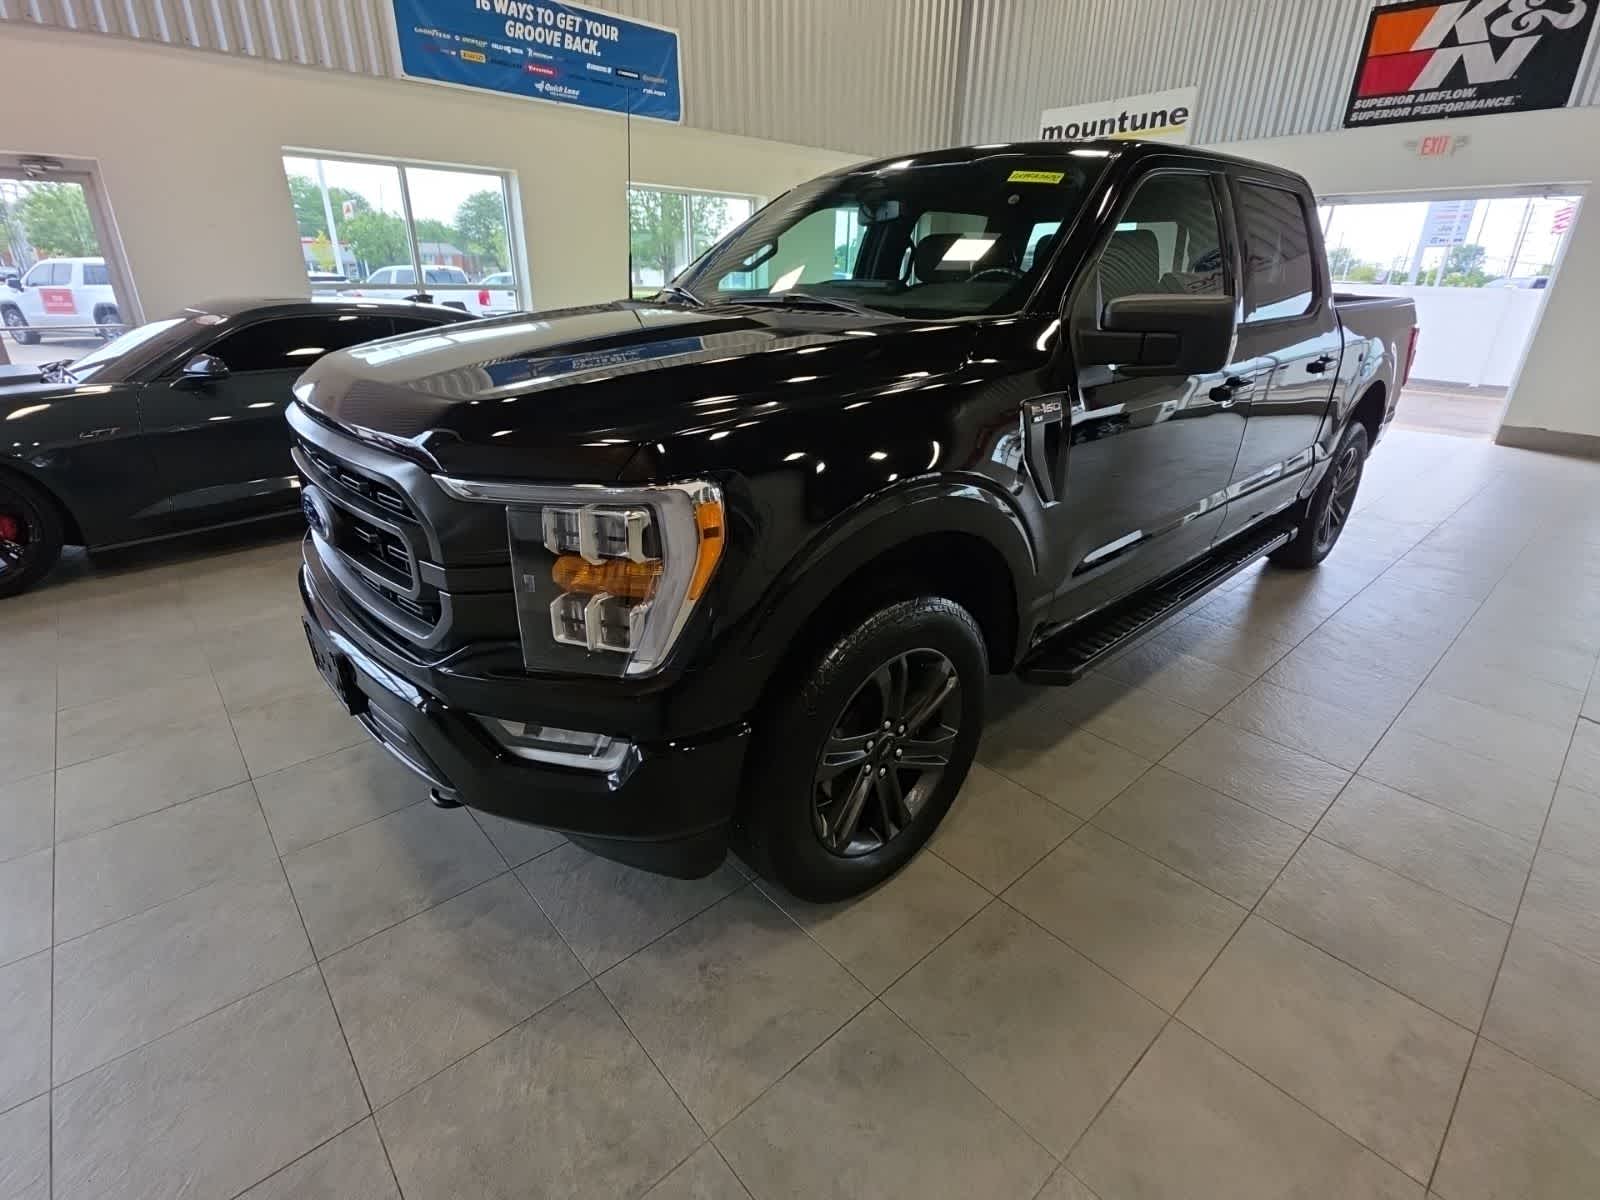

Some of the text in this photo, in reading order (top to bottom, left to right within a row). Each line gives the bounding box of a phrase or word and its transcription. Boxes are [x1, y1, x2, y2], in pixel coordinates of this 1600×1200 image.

[475, 0, 619, 42] 16 WAYS TO GET YOUR
[505, 20, 562, 48] GROOVE
[564, 33, 601, 57] BACK.
[1353, 87, 1477, 109] SUPERIOR AIRFLOW.
[1042, 106, 1189, 141] mountune
[1350, 106, 1411, 121] SUPERIOR
[1421, 135, 1449, 155] EXIT
[1032, 402, 1061, 415] F-150
